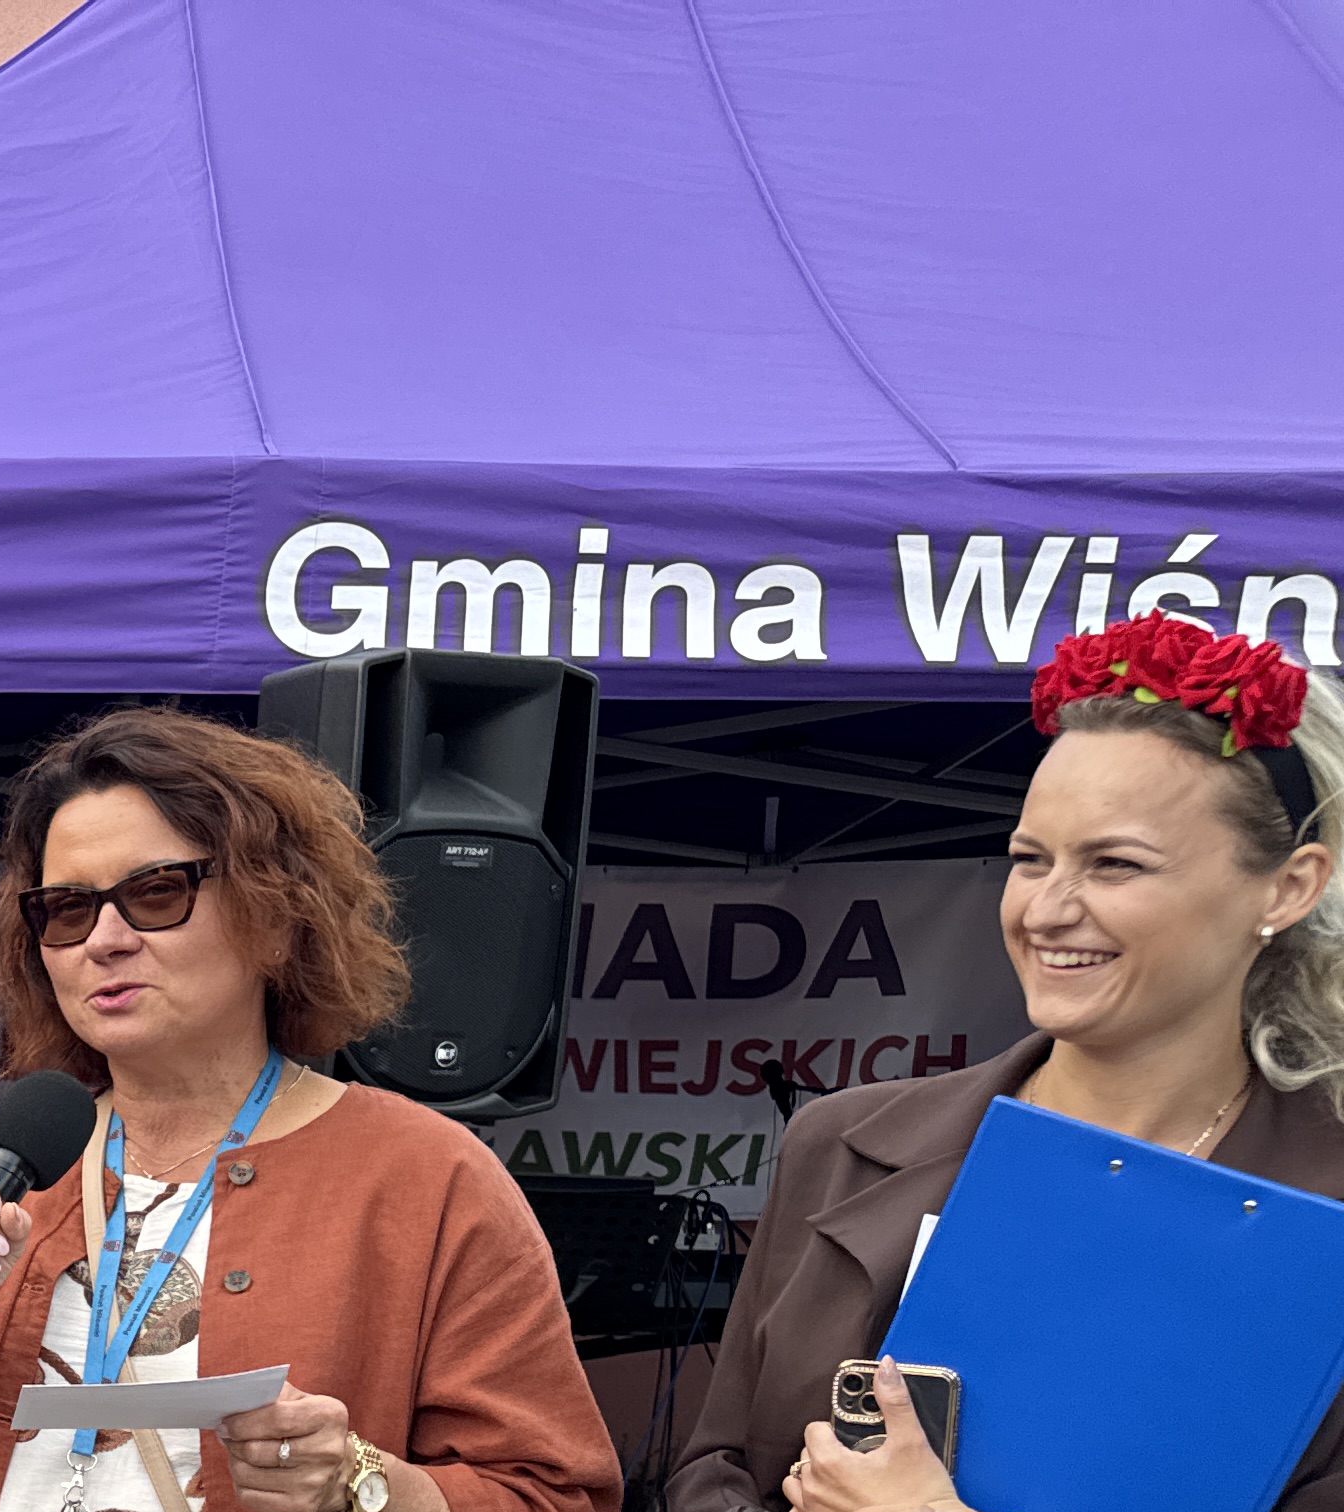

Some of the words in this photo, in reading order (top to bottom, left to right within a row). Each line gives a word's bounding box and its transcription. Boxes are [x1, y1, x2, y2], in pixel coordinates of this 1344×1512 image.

[265, 521, 828, 661] Gmina
[571, 900, 907, 1000] IADA
[507, 1129, 767, 1187] AWSKI
